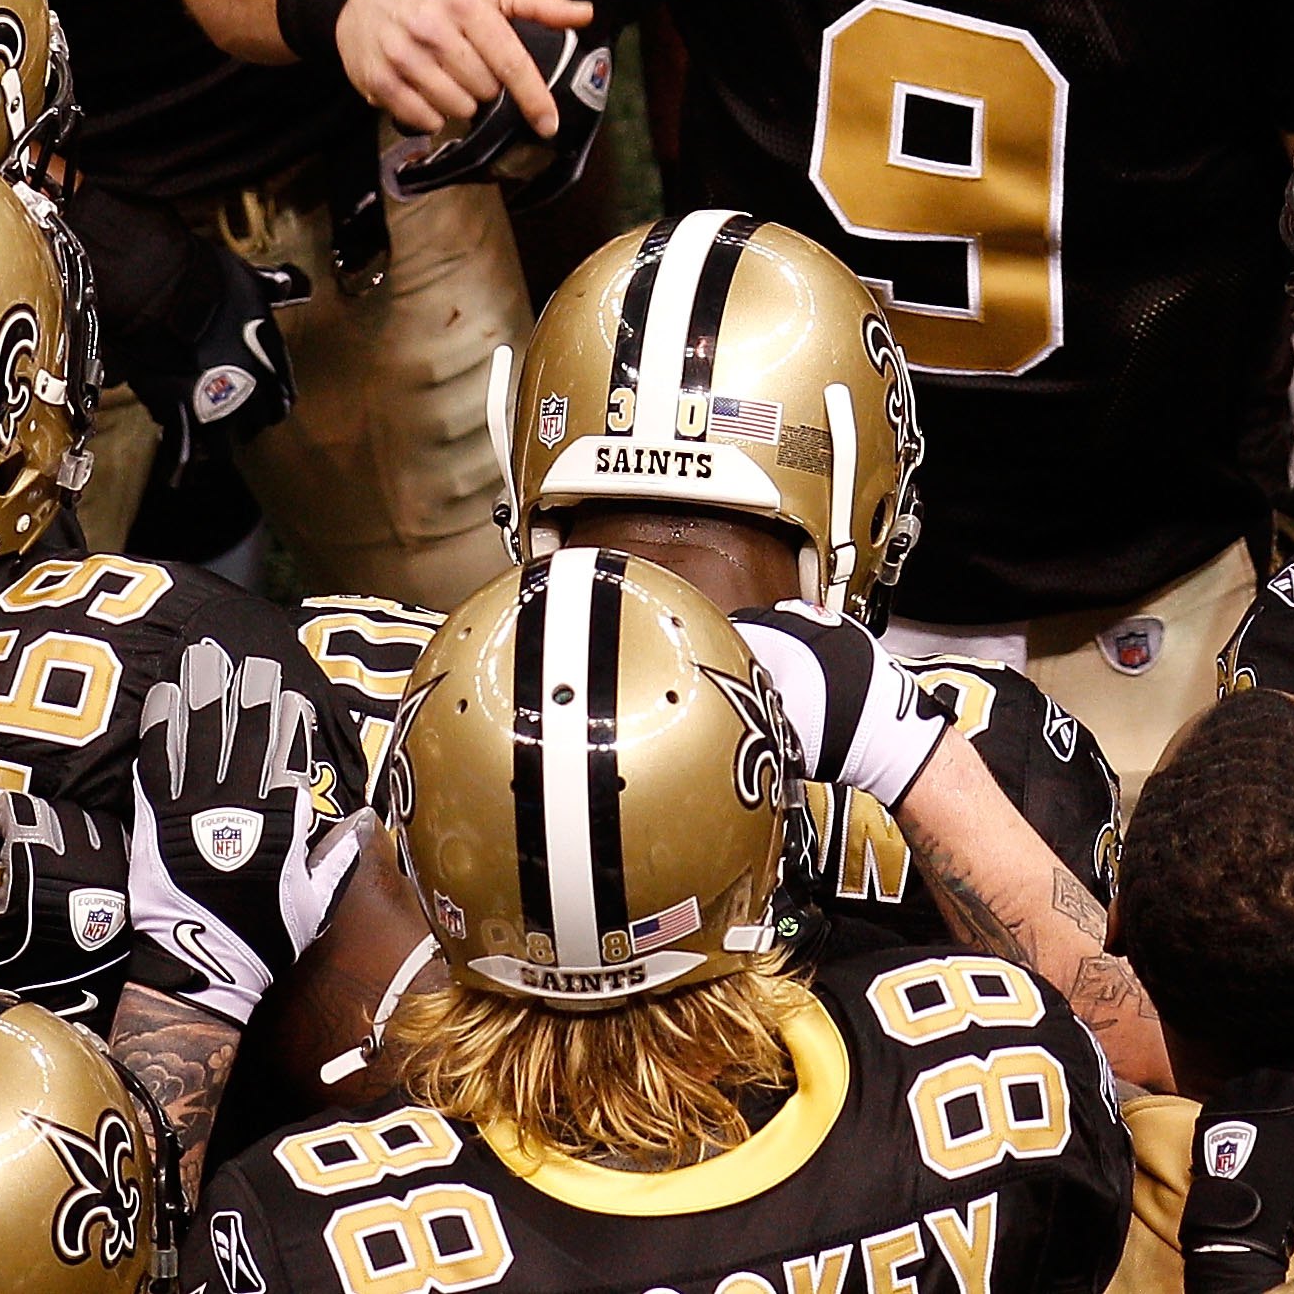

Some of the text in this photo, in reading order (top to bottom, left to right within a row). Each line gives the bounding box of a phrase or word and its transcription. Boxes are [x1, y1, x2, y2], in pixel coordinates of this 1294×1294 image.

[541, 414, 563, 437] NFL
[607, 388, 708, 440] 3 0
[595, 446, 713, 479] SAINTS
[200, 814, 255, 828] EQUIPMENT
[215, 838, 242, 858] NFL
[79, 896, 126, 912] EQUIPMENT
[84, 921, 108, 941] NFL
[525, 929, 632, 964] 8 8
[519, 964, 649, 994] SAINTS
[864, 954, 1072, 1182] 88
